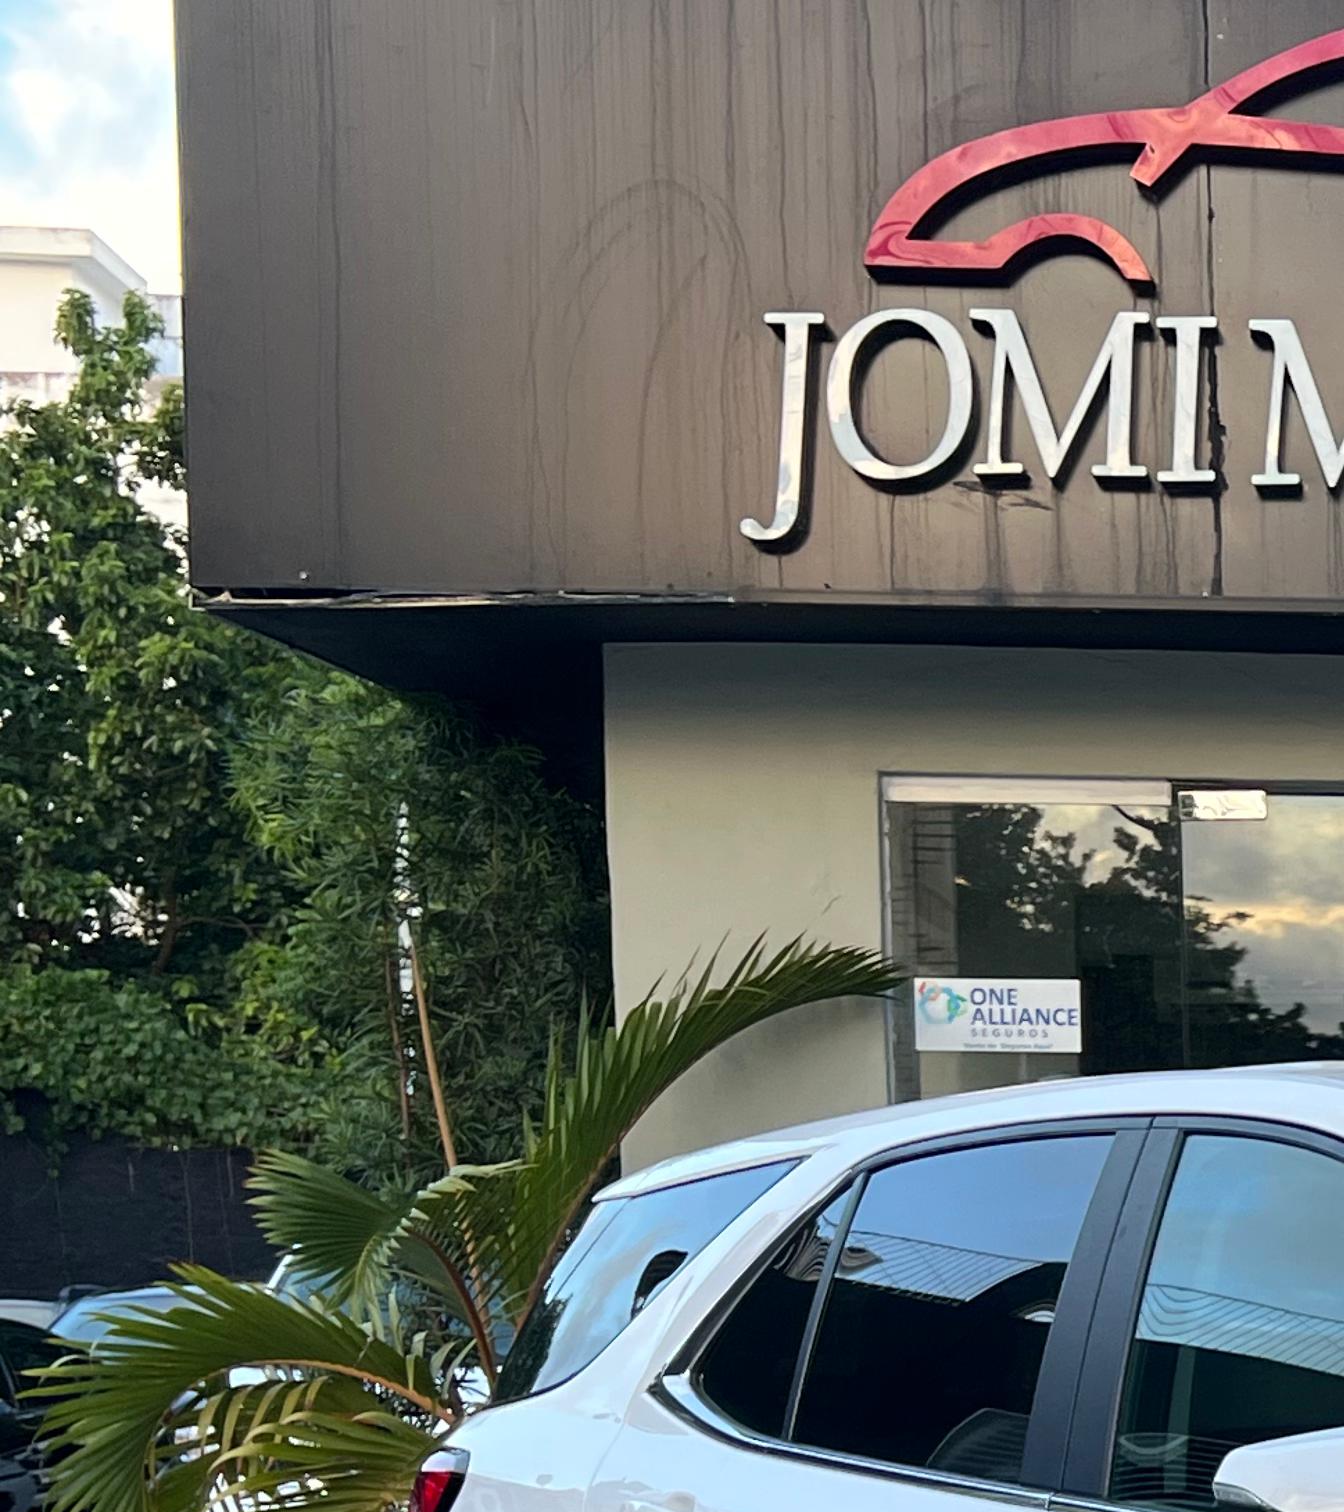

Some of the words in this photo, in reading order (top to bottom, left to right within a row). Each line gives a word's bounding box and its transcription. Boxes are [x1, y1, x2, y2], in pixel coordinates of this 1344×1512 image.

[739, 308, 1218, 544] JOMI
[969, 987, 1018, 1006] ONE
[970, 1007, 1079, 1026] ALLIANCE
[970, 1028, 1049, 1039] SEGUROS
